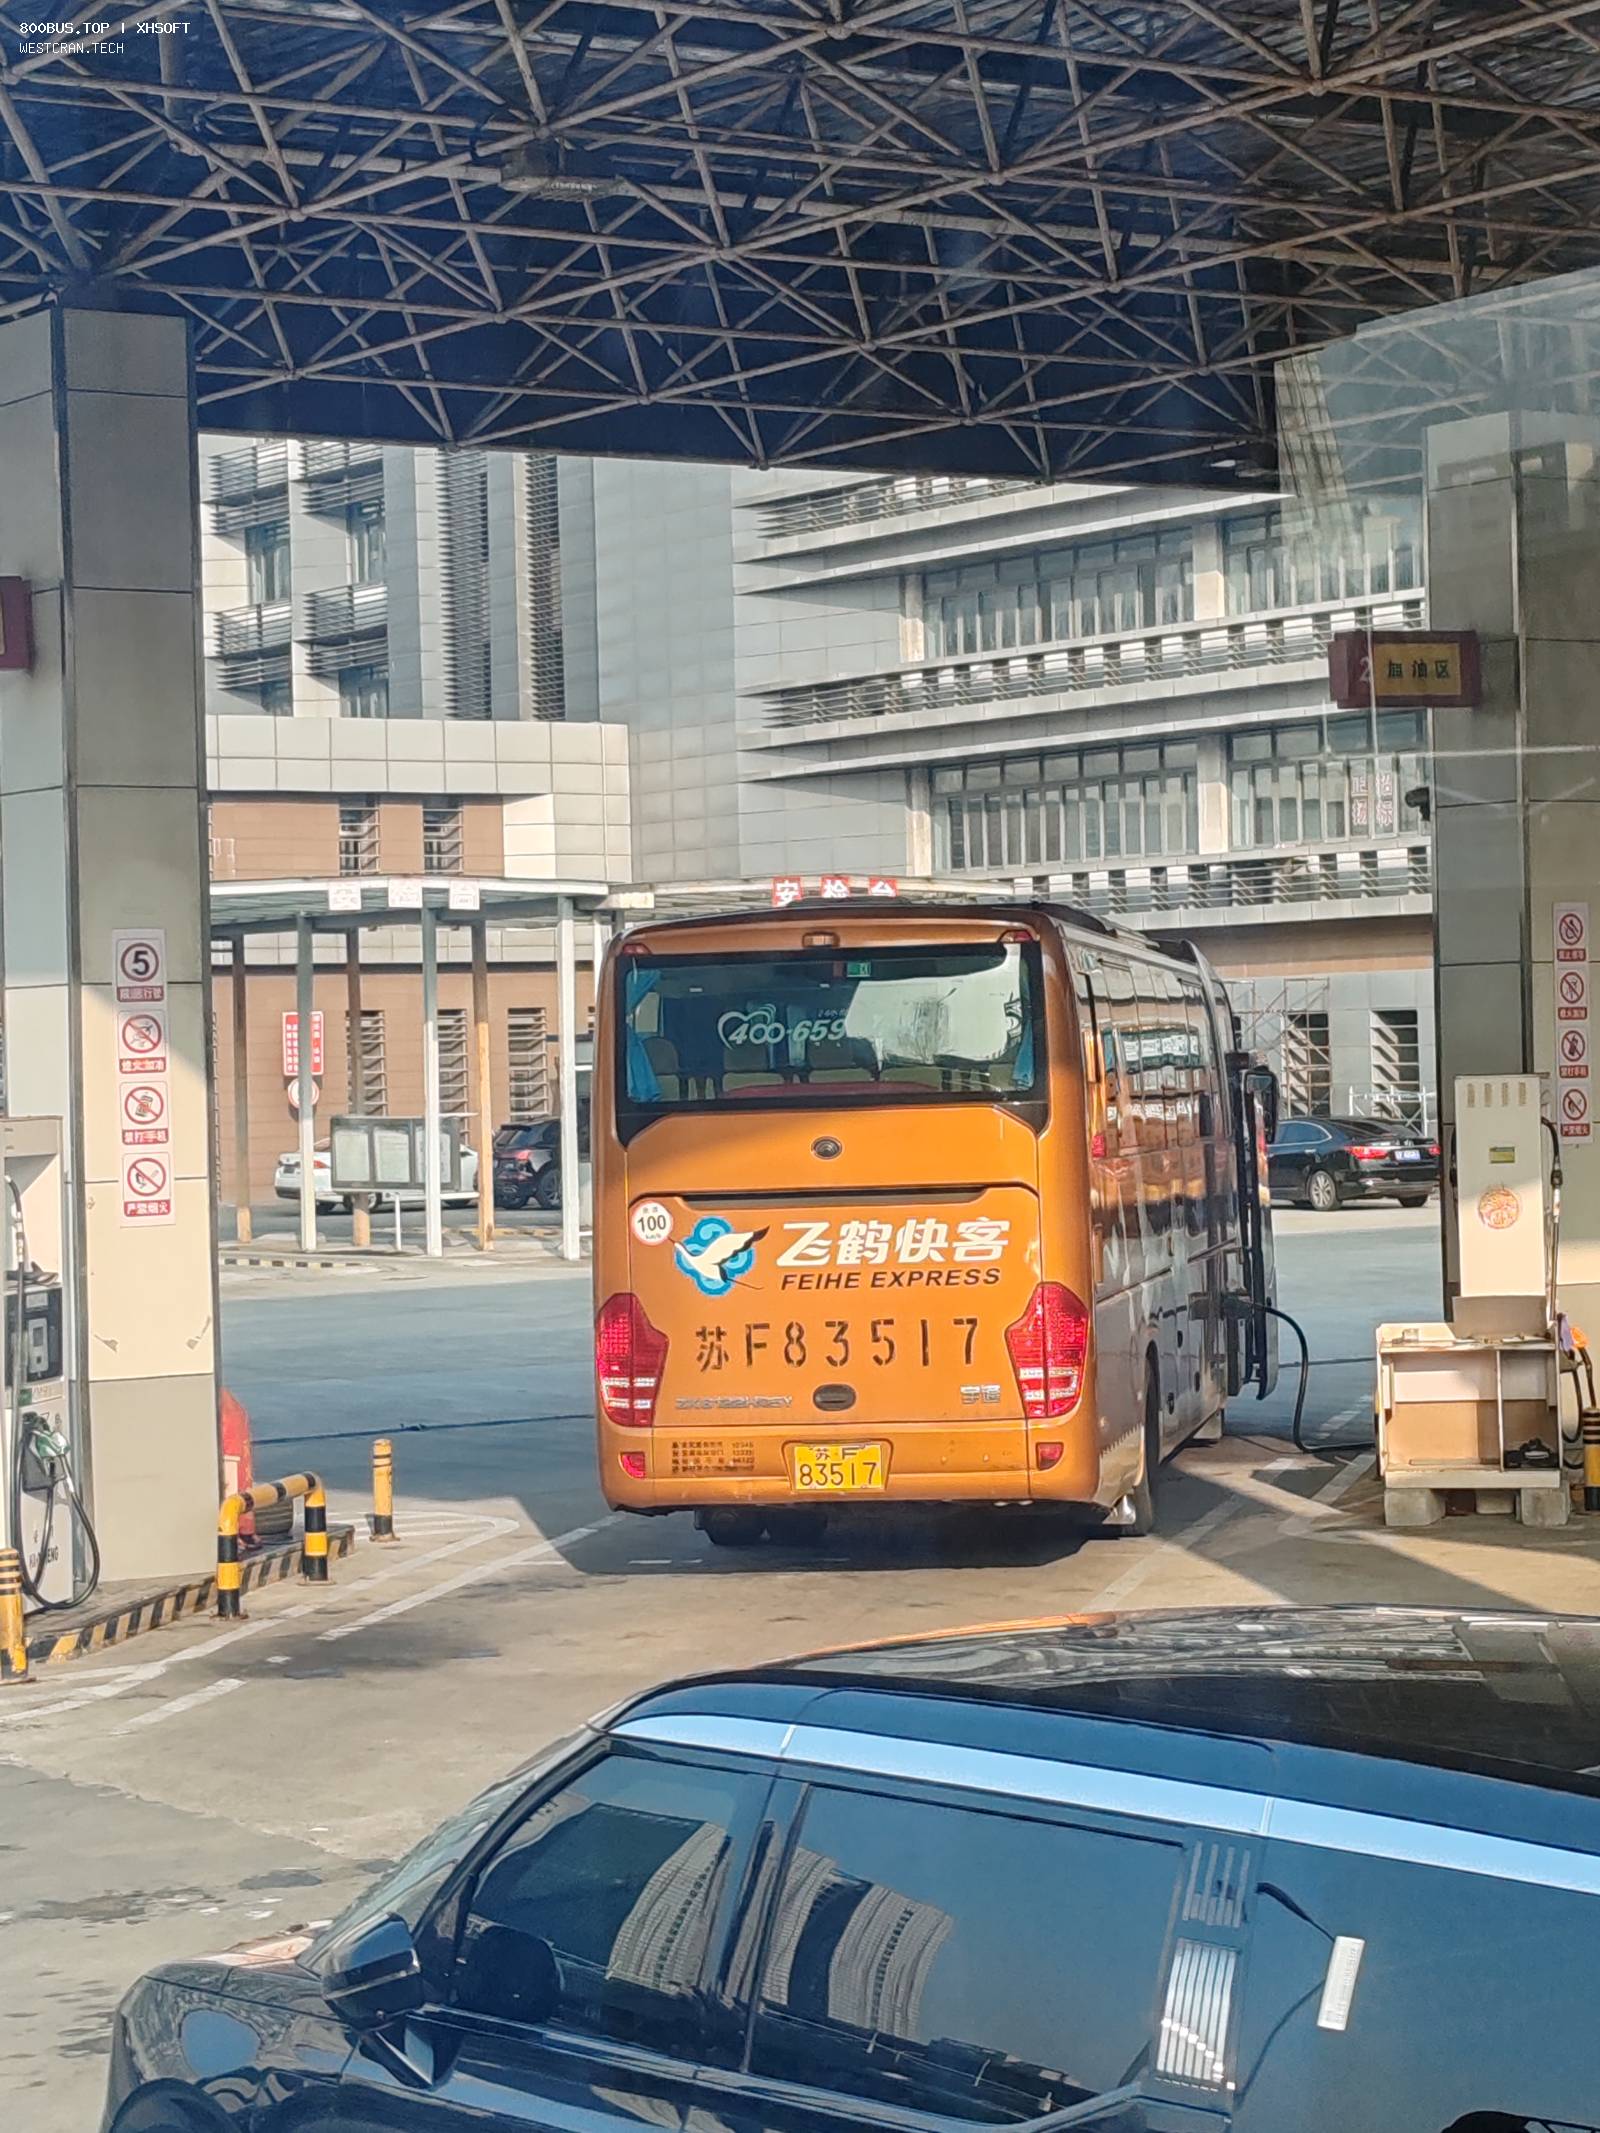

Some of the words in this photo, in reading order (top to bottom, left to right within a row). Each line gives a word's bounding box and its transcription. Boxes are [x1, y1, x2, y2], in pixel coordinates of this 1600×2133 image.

[1388, 658, 1450, 679] 加油区
[131, 950, 151, 976] 5
[637, 1214, 667, 1233] 100
[776, 1216, 1010, 1267] 飞鹤快客
[781, 1271, 861, 1290] FEIHE
[870, 1268, 1001, 1289] EXPRESS
[695, 1318, 978, 1372] 苏F83517
[799, 1462, 877, 1486] 83517
